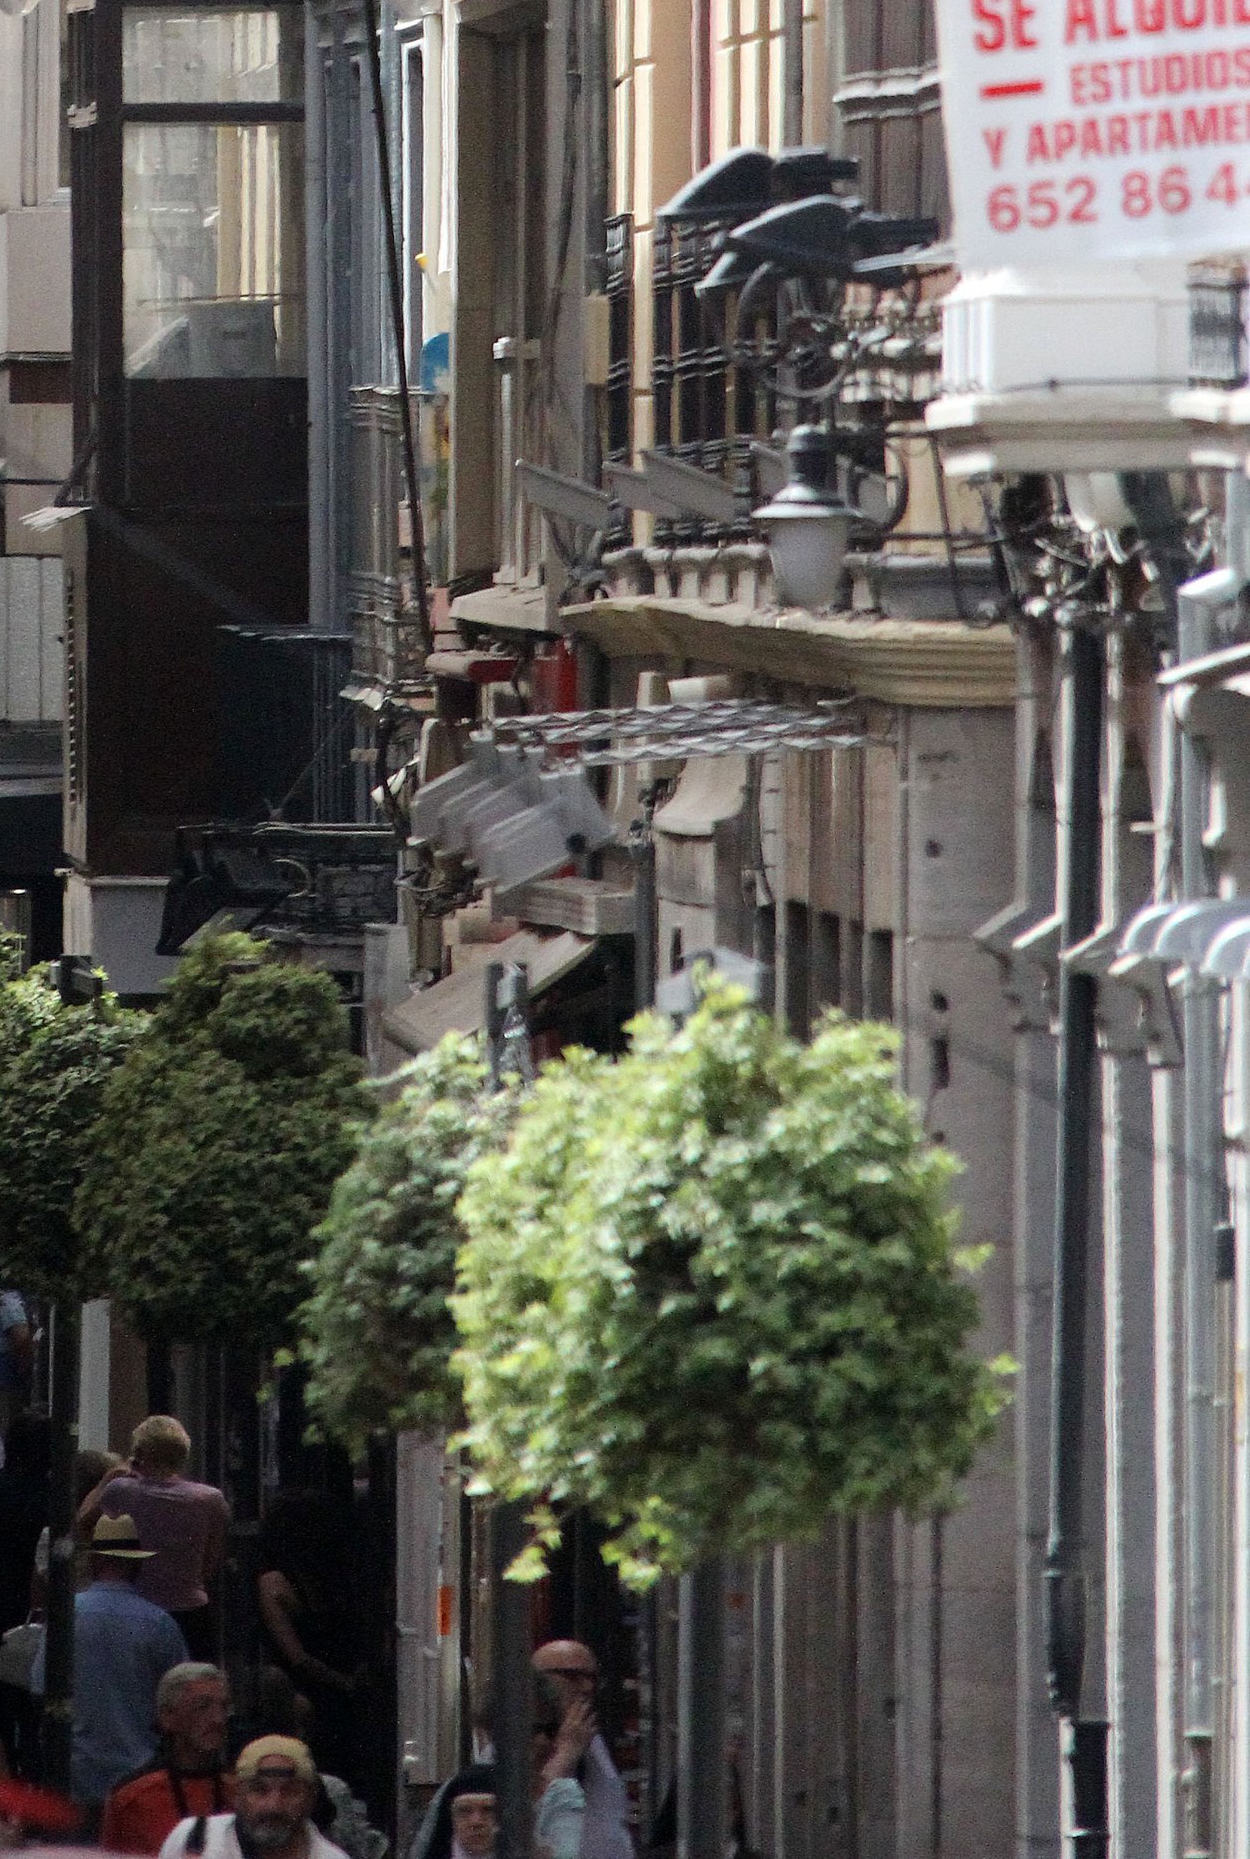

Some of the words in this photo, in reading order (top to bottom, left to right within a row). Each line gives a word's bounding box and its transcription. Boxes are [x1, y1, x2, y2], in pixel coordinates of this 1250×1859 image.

[1070, 47, 1250, 105] ESTUDIOS
[983, 127, 1007, 170] Y
[1027, 102, 1250, 165] APARTAME
[987, 175, 1098, 233] 652
[1122, 165, 1192, 219] 86
[1206, 162, 1250, 207] 4
